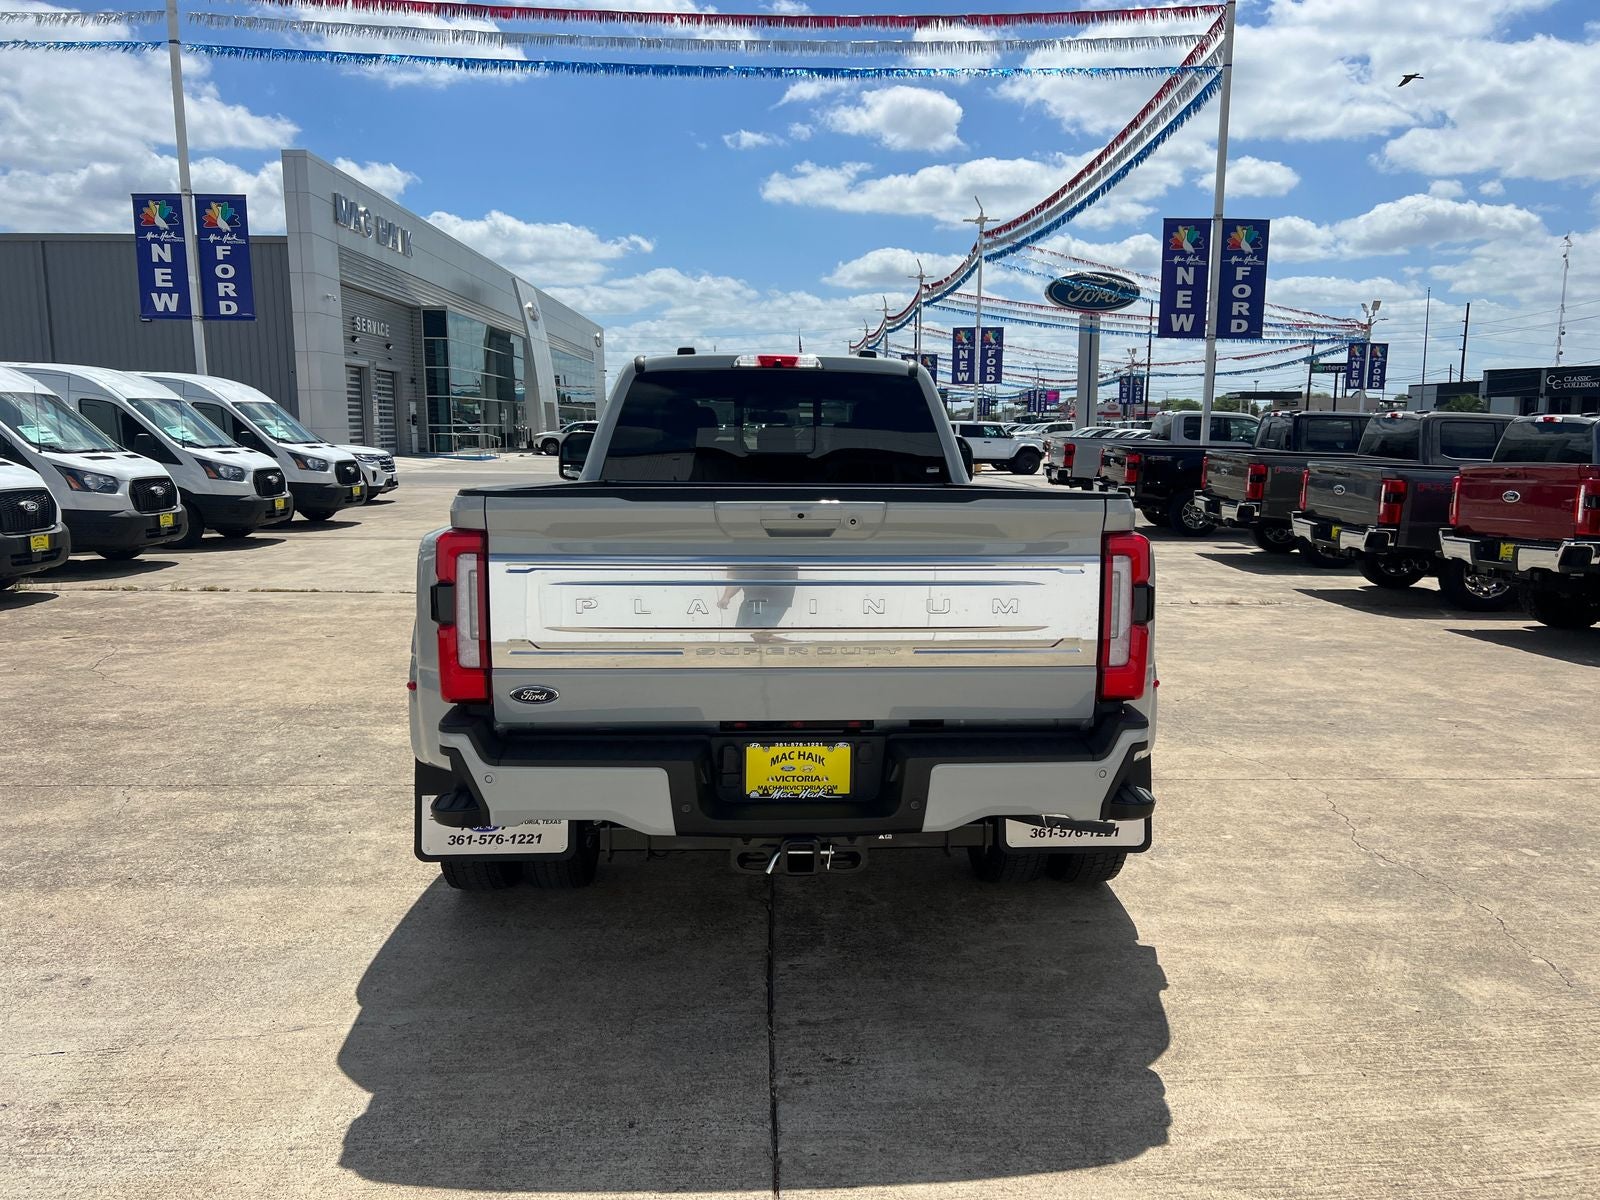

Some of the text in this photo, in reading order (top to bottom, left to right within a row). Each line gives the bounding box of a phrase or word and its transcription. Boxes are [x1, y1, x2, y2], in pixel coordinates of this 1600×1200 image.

[333, 193, 413, 257] MAC HAIK
[150, 243, 179, 312] NEW
[214, 245, 238, 315] FORD
[1067, 280, 1121, 303] Ford
[1170, 266, 1195, 332] NEW
[1230, 266, 1251, 334] FORD
[354, 316, 390, 337] SERVICE
[957, 350, 969, 381] NEW
[986, 350, 996, 382] FORD
[1350, 361, 1360, 387] NEW
[1372, 361, 1382, 388] FORD
[575, 598, 1019, 614] PLATINUM
[696, 646, 901, 655] SUPER DUTY
[770, 750, 826, 767] MAC HAIK
[770, 788, 829, 799] Mac Haik
[447, 833, 543, 846] 361-576-1221
